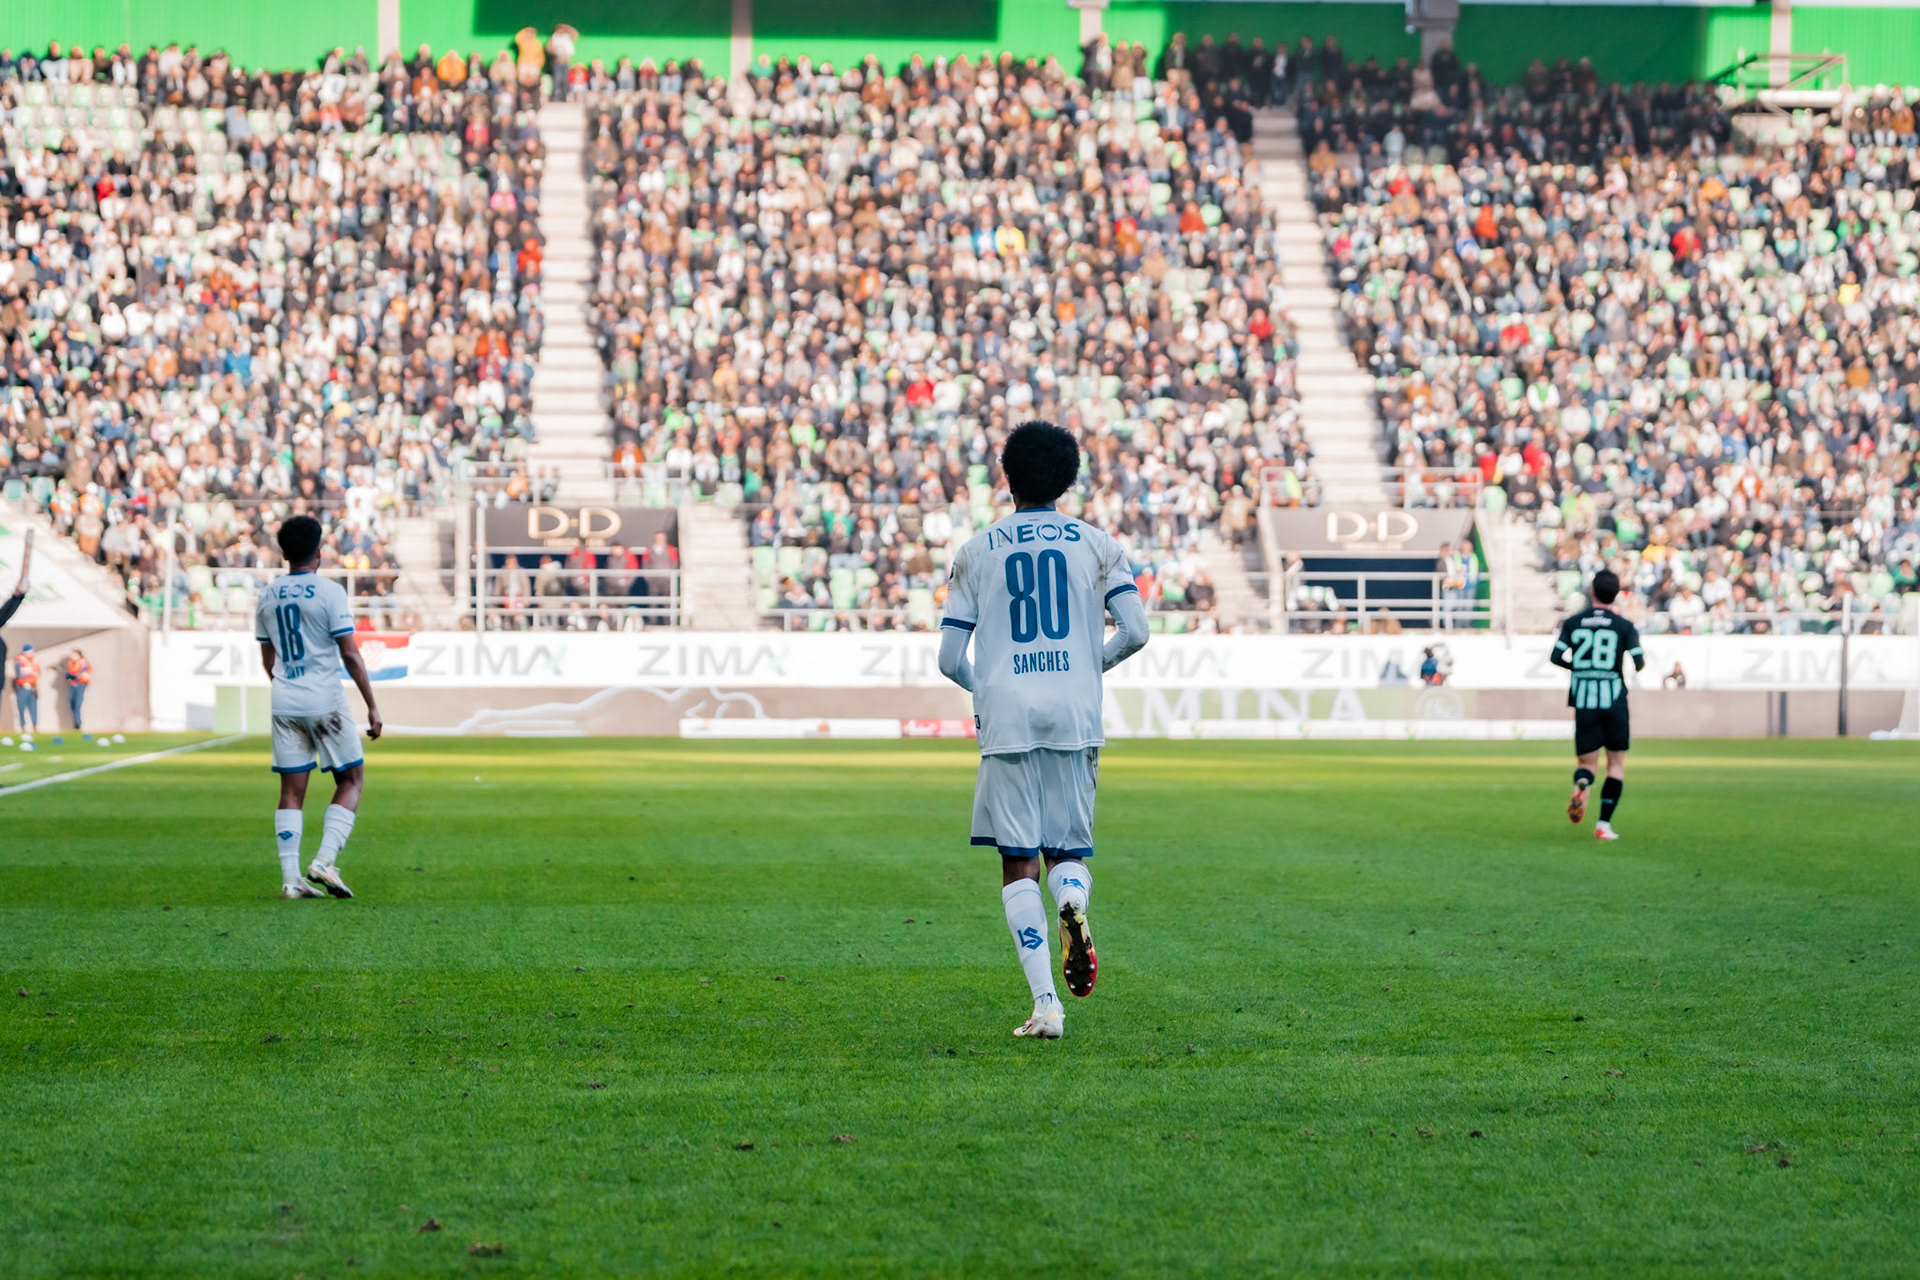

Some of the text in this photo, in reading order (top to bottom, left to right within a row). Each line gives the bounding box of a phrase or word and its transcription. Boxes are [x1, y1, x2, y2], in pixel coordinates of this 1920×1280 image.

[988, 523, 1081, 550] INEOS
[1005, 549, 1070, 643] 80
[275, 603, 305, 662] 18
[1571, 628, 1618, 670] 28
[1014, 651, 1070, 674] SANCHES
